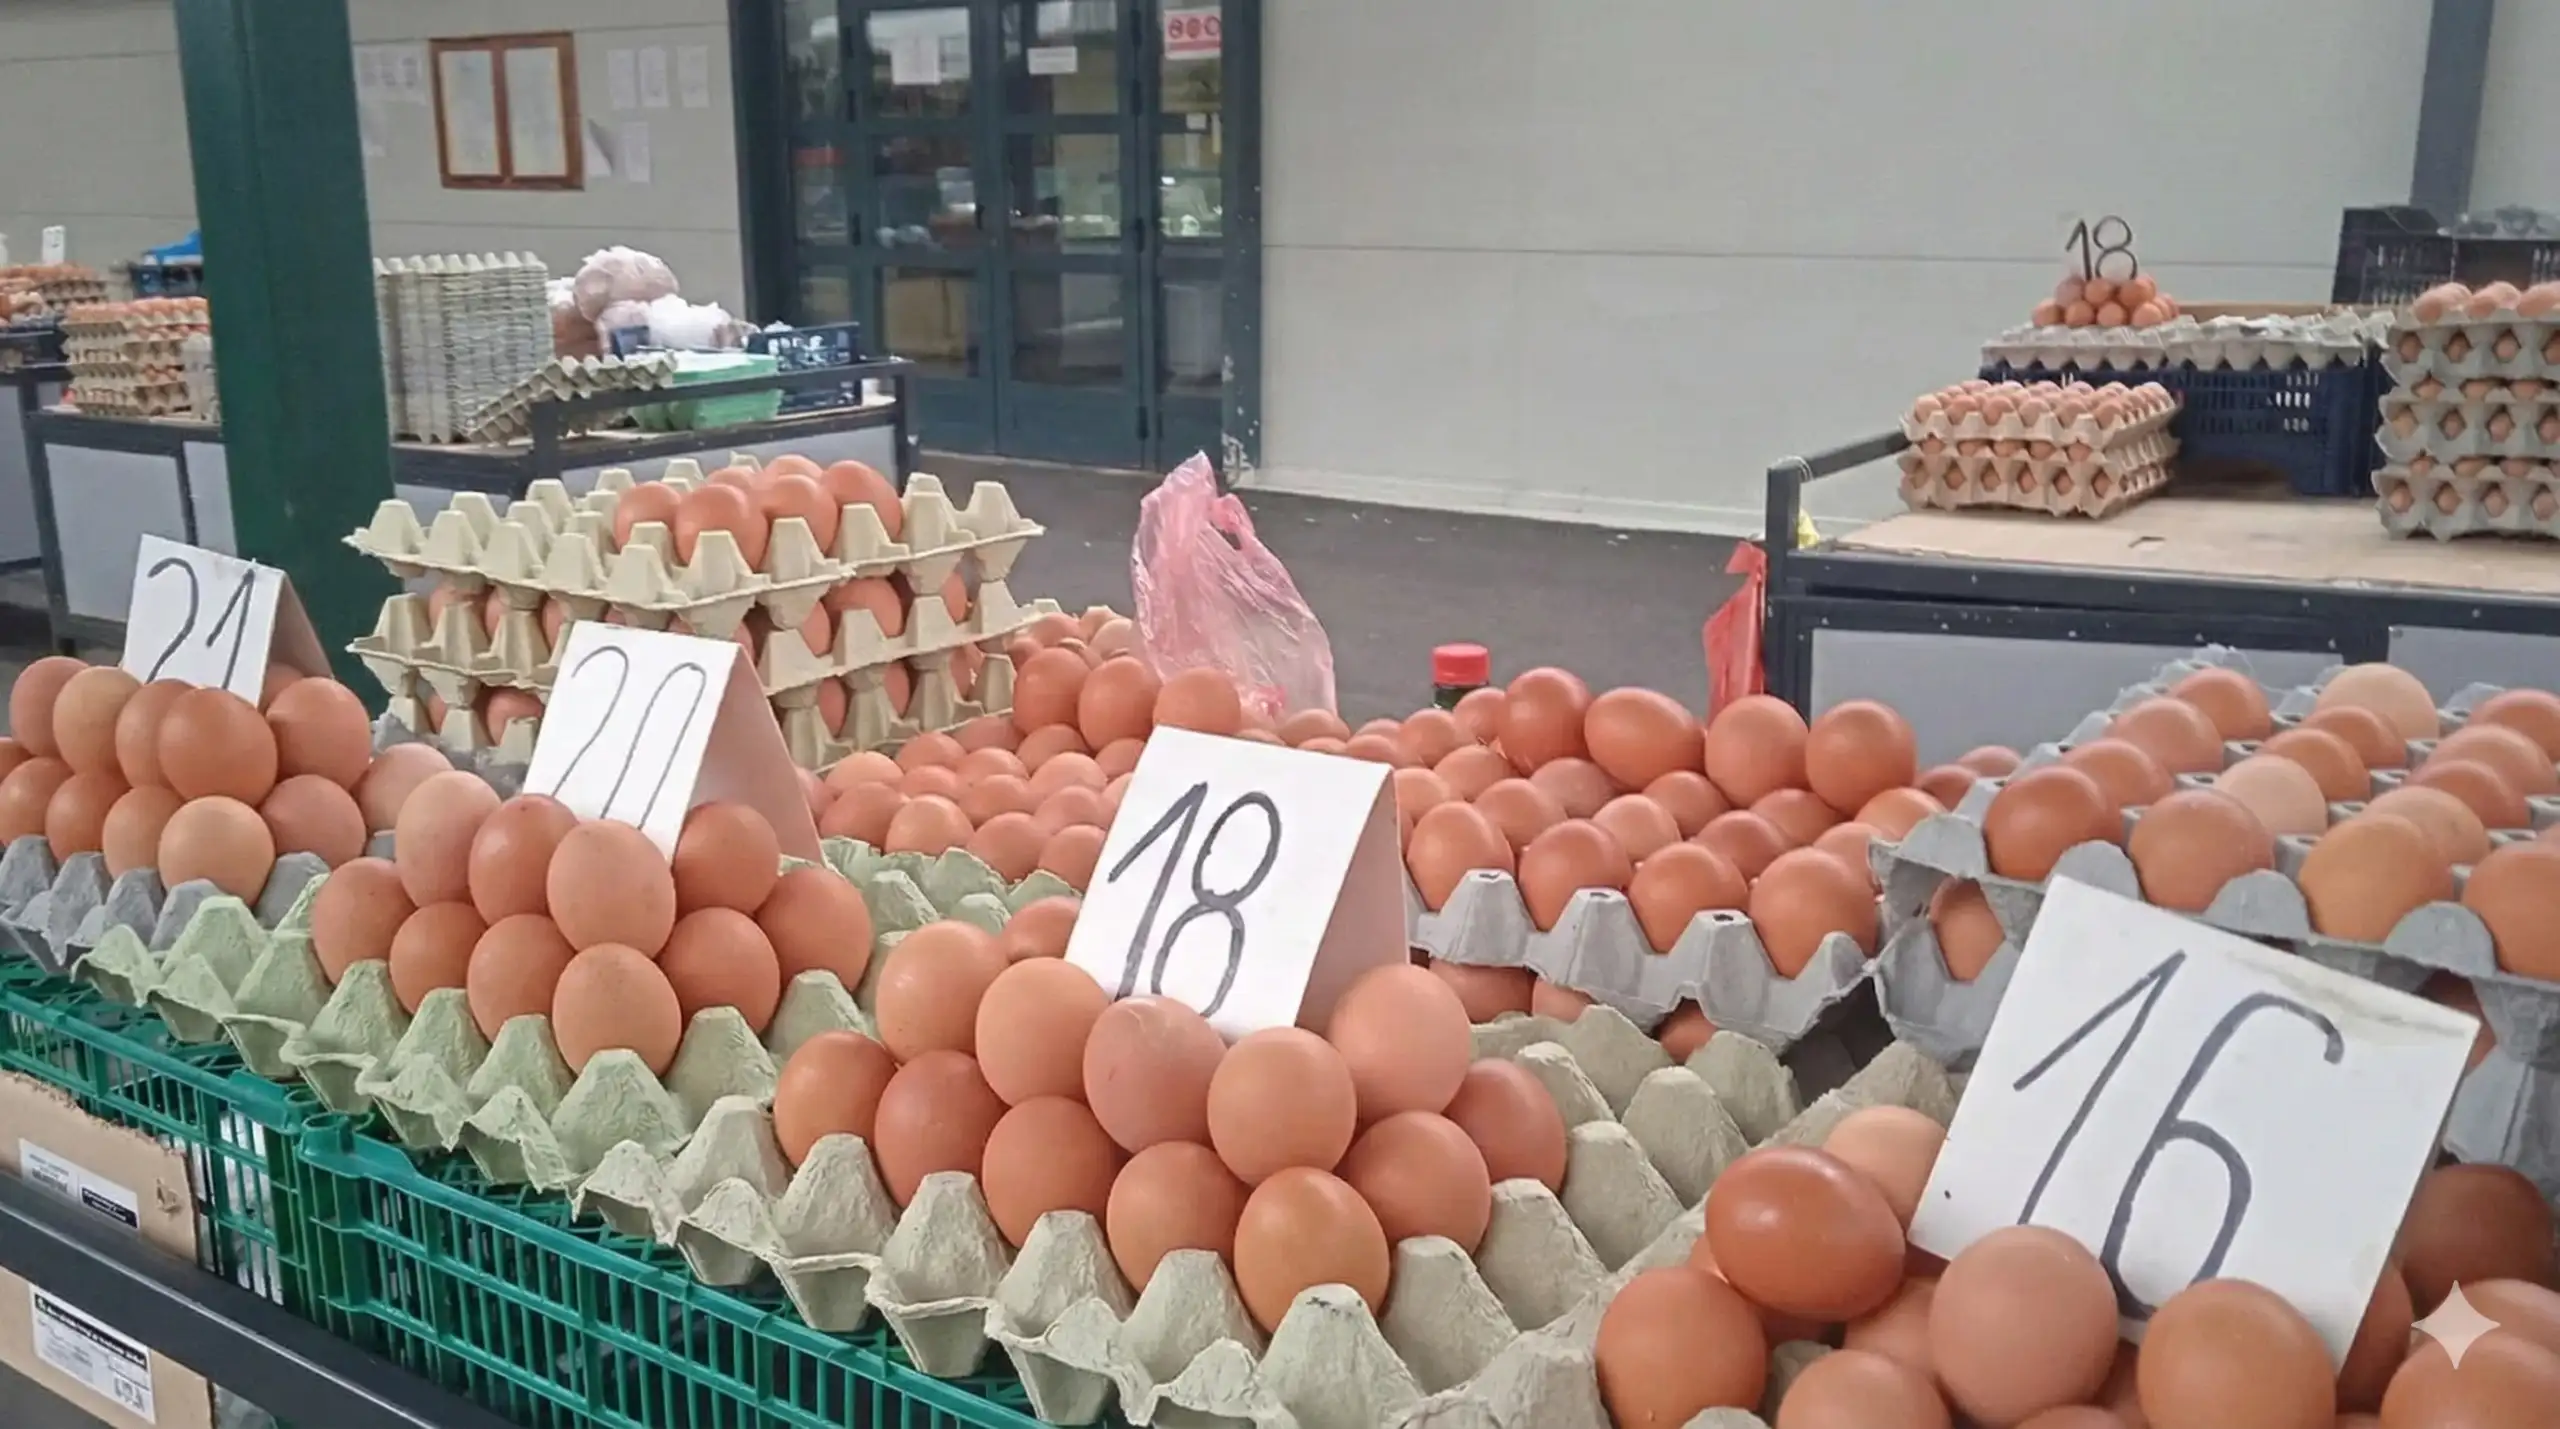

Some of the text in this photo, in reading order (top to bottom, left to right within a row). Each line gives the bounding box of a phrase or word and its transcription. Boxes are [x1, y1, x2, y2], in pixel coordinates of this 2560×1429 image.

[2065, 214, 2137, 281] 18
[147, 556, 255, 690] 21
[551, 644, 707, 830] 20
[1107, 780, 1282, 1018] 18
[2012, 948, 2344, 1321] 16
